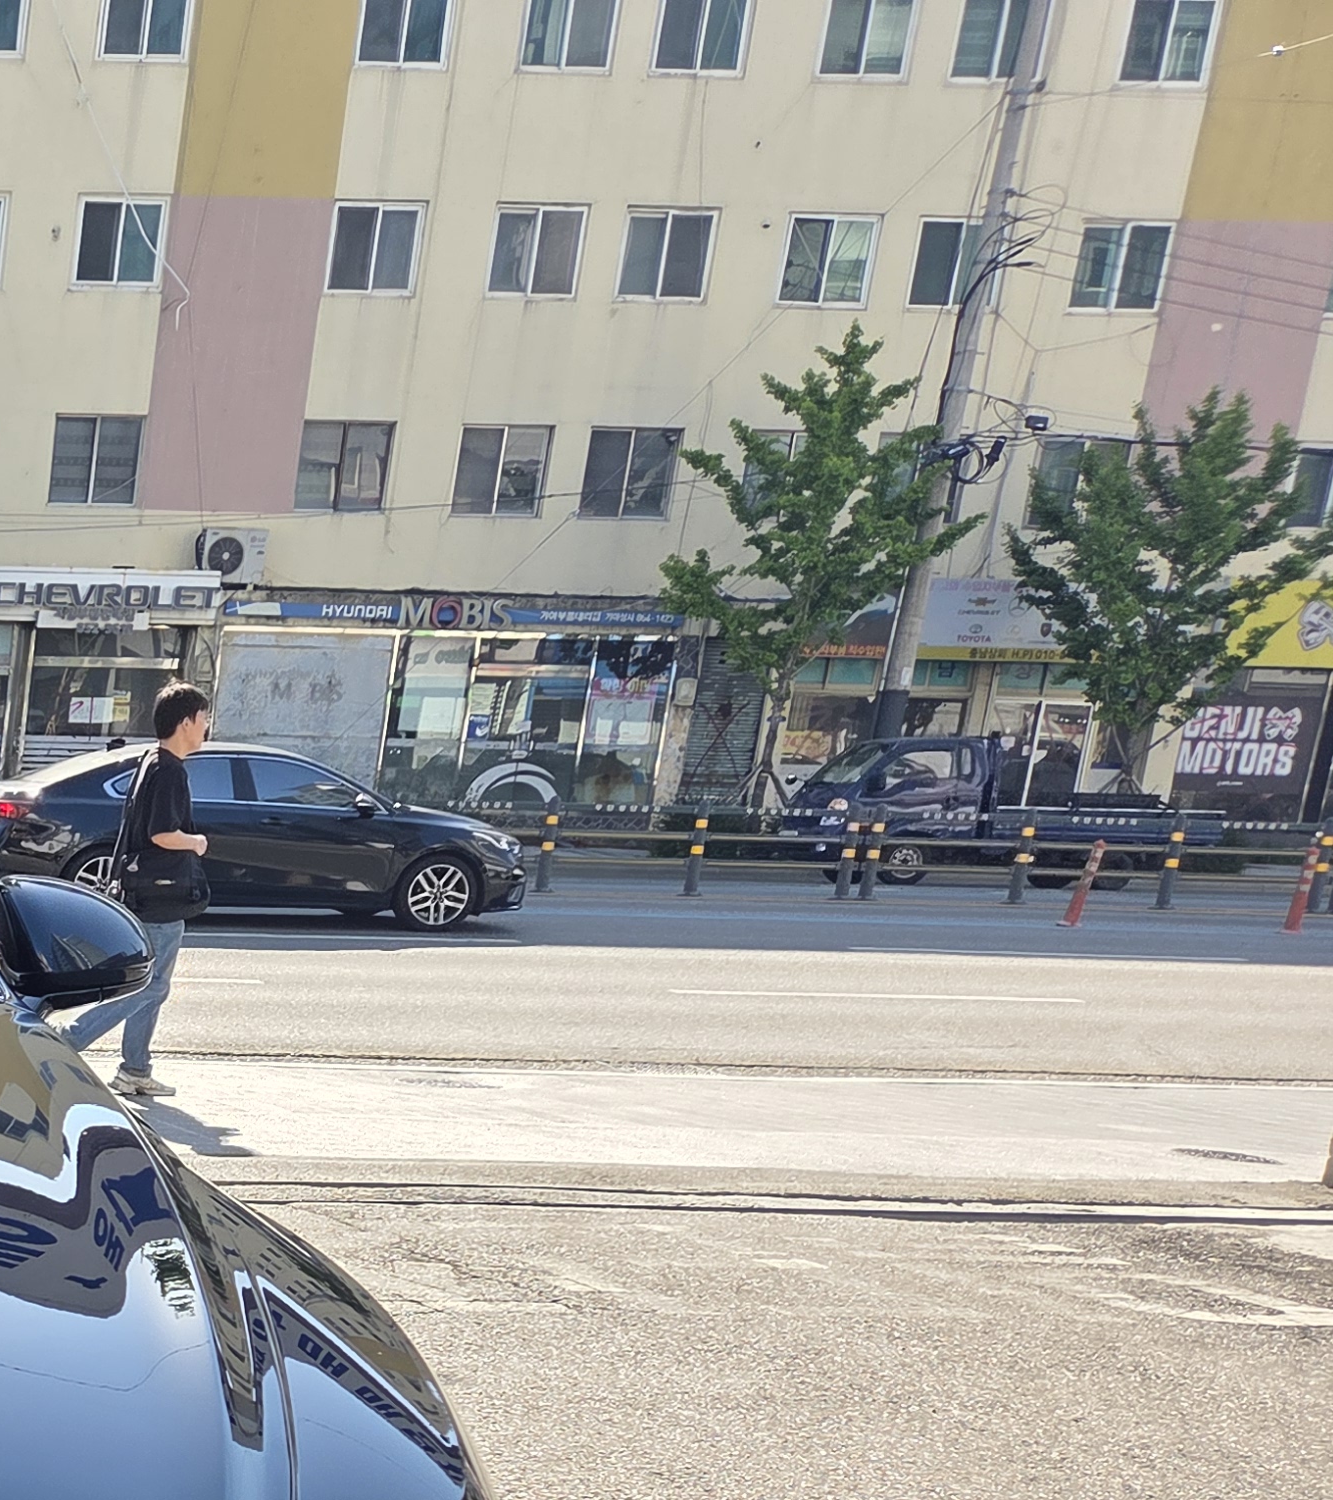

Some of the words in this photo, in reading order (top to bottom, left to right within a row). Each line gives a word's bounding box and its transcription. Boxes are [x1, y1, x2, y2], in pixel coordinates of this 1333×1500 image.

[321, 603, 393, 619] HYUNDAI
[398, 595, 516, 630] MOBIS
[956, 634, 992, 643] TOYOTA
[1175, 740, 1298, 777] MOTORS
